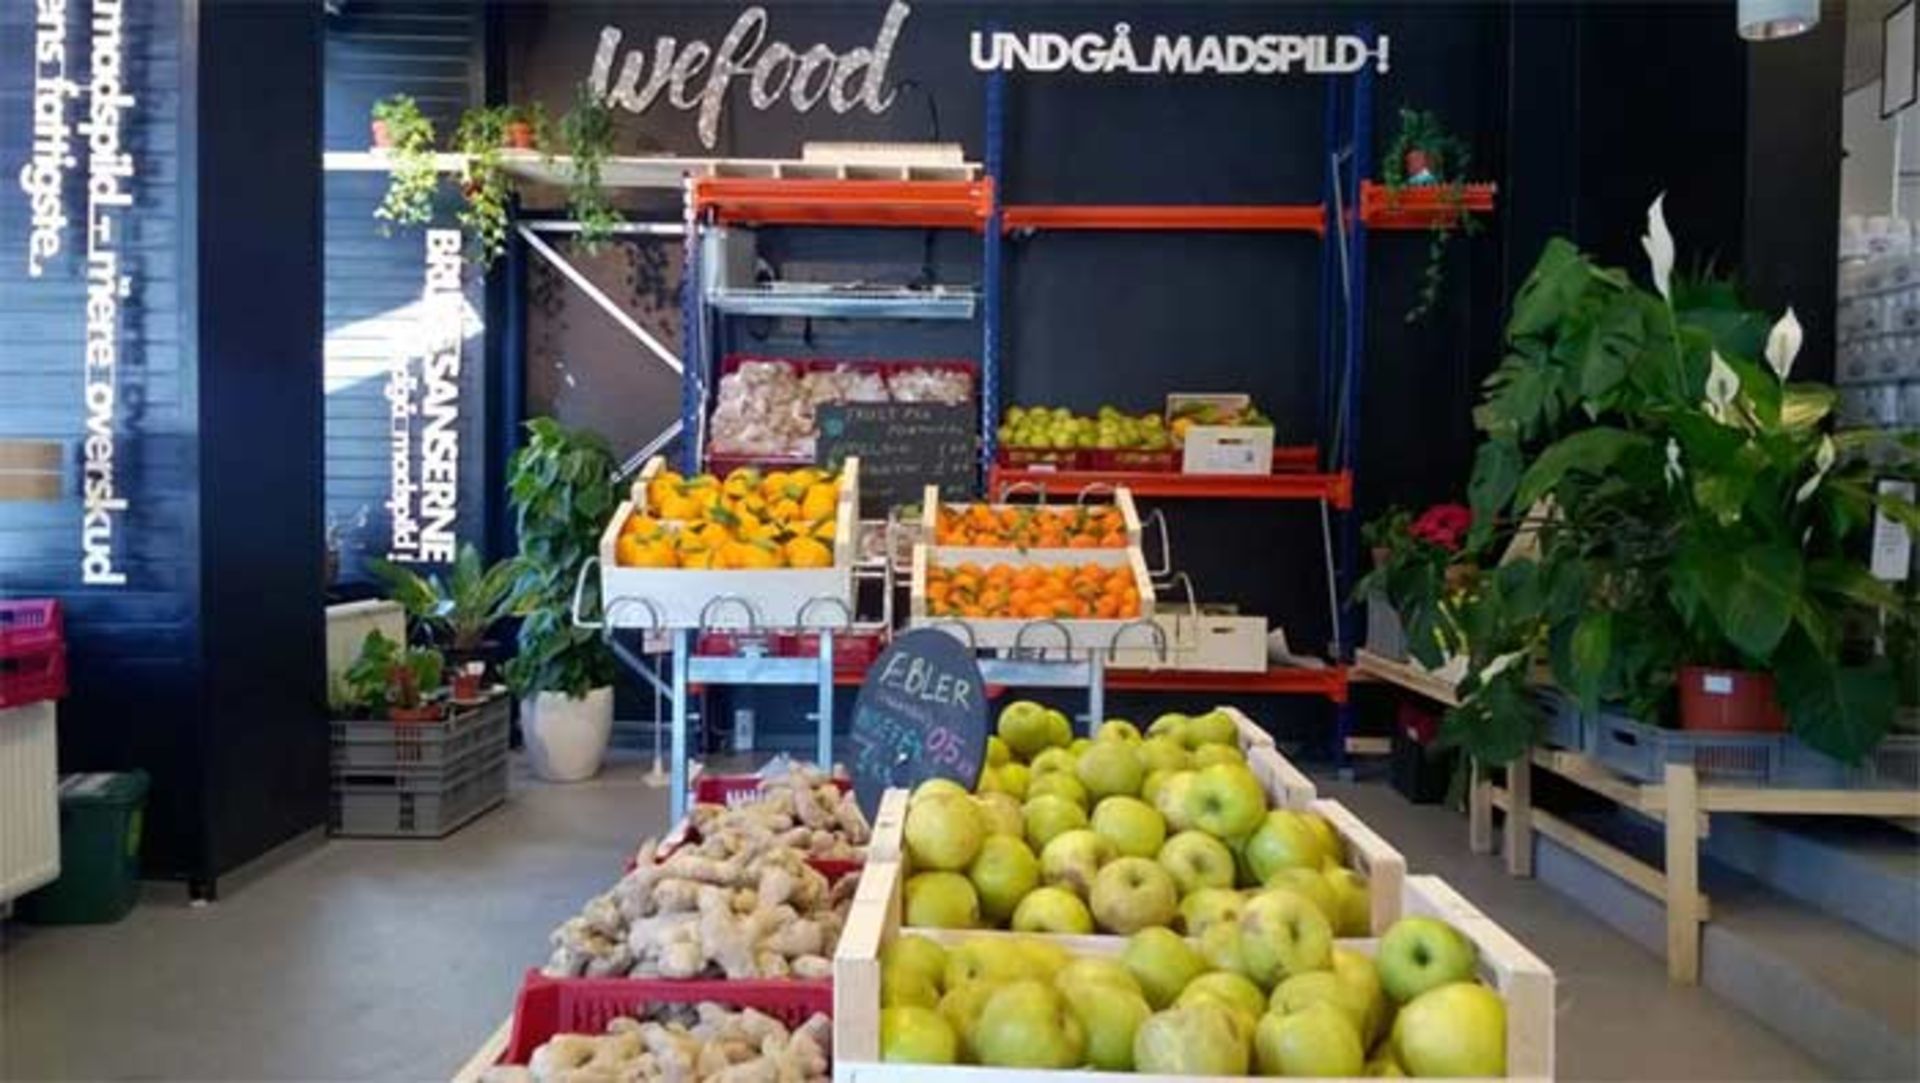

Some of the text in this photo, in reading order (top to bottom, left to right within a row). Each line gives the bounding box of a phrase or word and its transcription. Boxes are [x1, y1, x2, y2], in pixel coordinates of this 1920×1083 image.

[77, 1, 135, 206] madspild
[588, 1, 911, 149] wefood
[970, 22, 1136, 71] UNDGÅ
[82, 384, 128, 585] overskud
[420, 229, 464, 562] BRU SANSERNE
